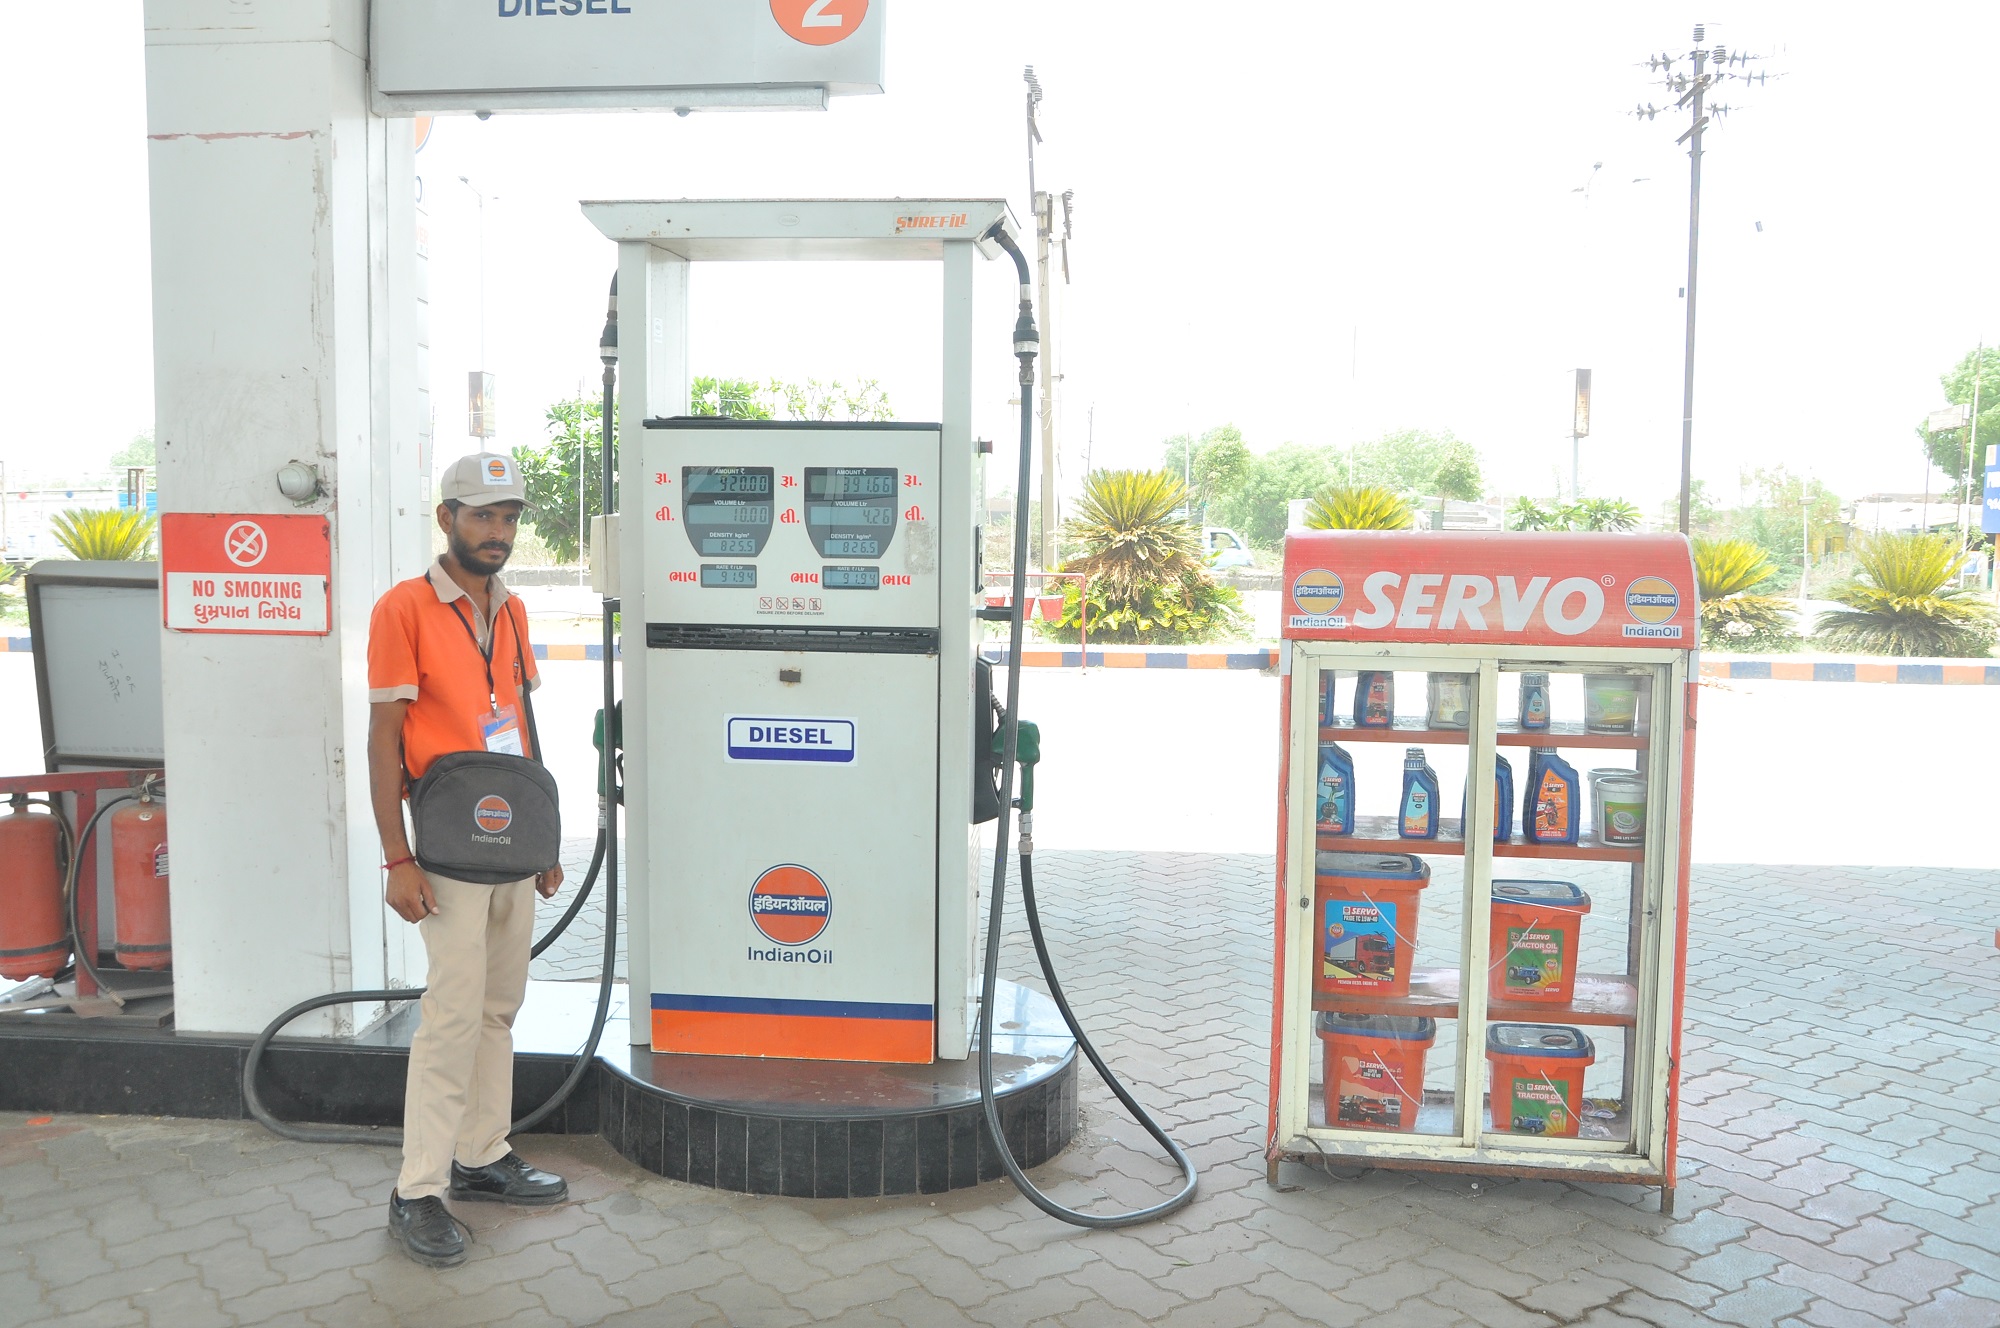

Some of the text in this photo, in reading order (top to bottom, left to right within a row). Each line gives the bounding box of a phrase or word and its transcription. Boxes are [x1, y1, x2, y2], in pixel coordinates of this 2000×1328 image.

[720, 476, 767, 492] 920.00
[843, 477, 890, 493] 391.66
[734, 507, 767, 522] 10.00
[863, 509, 890, 524] 4.26
[721, 541, 753, 552] 825.5
[843, 542, 876, 553] 826.5
[669, 571, 697, 583] ભાવ
[721, 571, 754, 583] 91.94
[790, 572, 819, 584] ભાવ
[843, 573, 876, 584] 91.94
[882, 574, 911, 586] ભાવ
[193, 579, 302, 599] NO SMOKING
[1352, 571, 1605, 636] SERVO
[258, 601, 301, 620] નિષેધ
[1292, 616, 1344, 627] IndianOil
[1625, 626, 1679, 637] IndianOil
[749, 726, 833, 745] DIESEL
[471, 833, 511, 845] IndianOil
[753, 895, 826, 912] इंडियनऑयल
[1351, 907, 1378, 916] SERVO
[1512, 941, 1544, 950] TRACTOR
[747, 946, 833, 964] IndianOil
[1533, 1084, 1555, 1092] SERVO
[1517, 1091, 1549, 1100] TRACTOR
